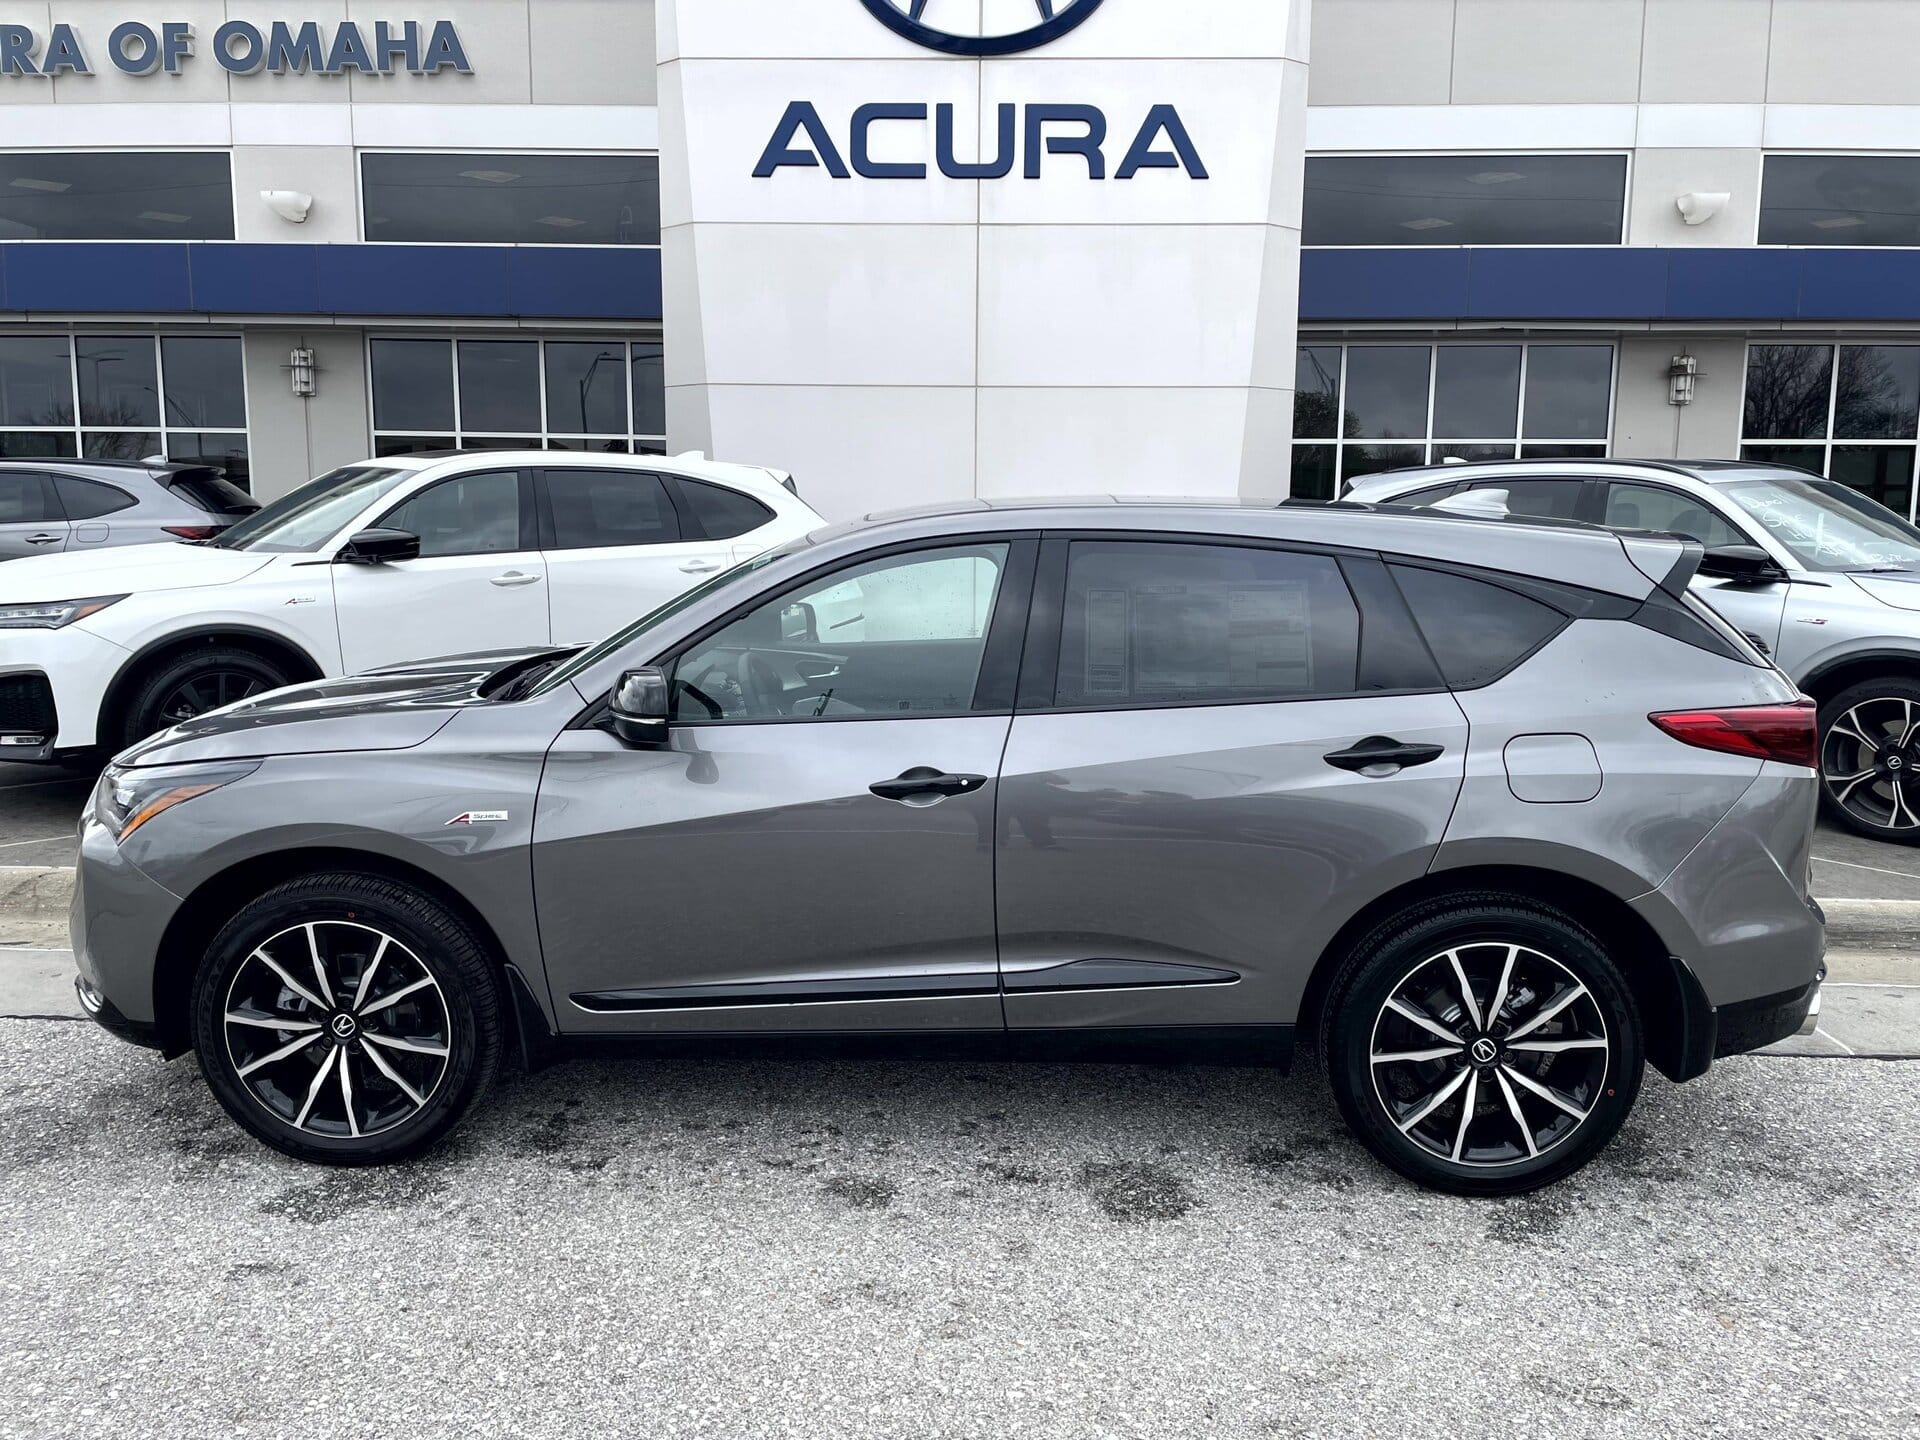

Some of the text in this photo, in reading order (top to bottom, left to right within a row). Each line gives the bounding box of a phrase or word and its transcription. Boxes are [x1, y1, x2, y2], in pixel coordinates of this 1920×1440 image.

[107, 21, 192, 74] OF
[213, 20, 472, 74] OMAHA
[751, 101, 1209, 179] ACURA
